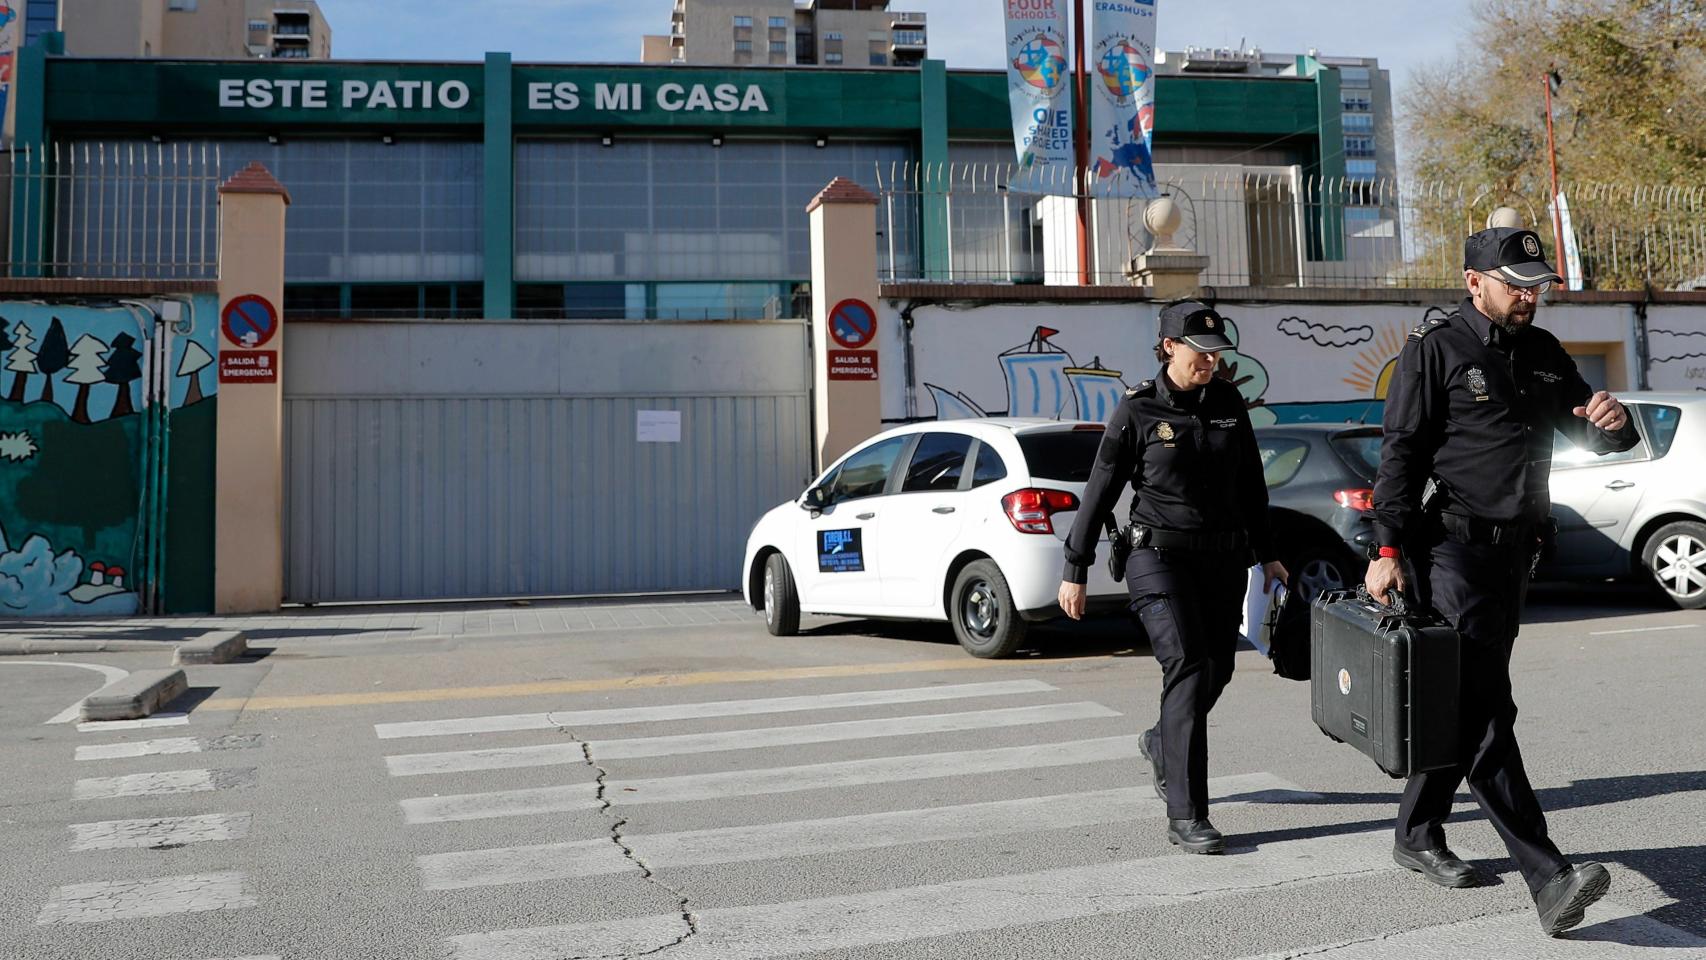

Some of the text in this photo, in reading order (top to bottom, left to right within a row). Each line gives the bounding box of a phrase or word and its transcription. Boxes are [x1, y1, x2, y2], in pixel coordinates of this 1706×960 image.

[1008, 0, 1054, 10] FOUR
[1096, 2, 1152, 16] ERASMUS+
[219, 79, 470, 109] ESTE PATIO
[528, 82, 769, 112] ES MI CASA
[1033, 108, 1068, 127] ONE
[1028, 122, 1068, 139] SHARED
[1023, 136, 1069, 150] PROJECT
